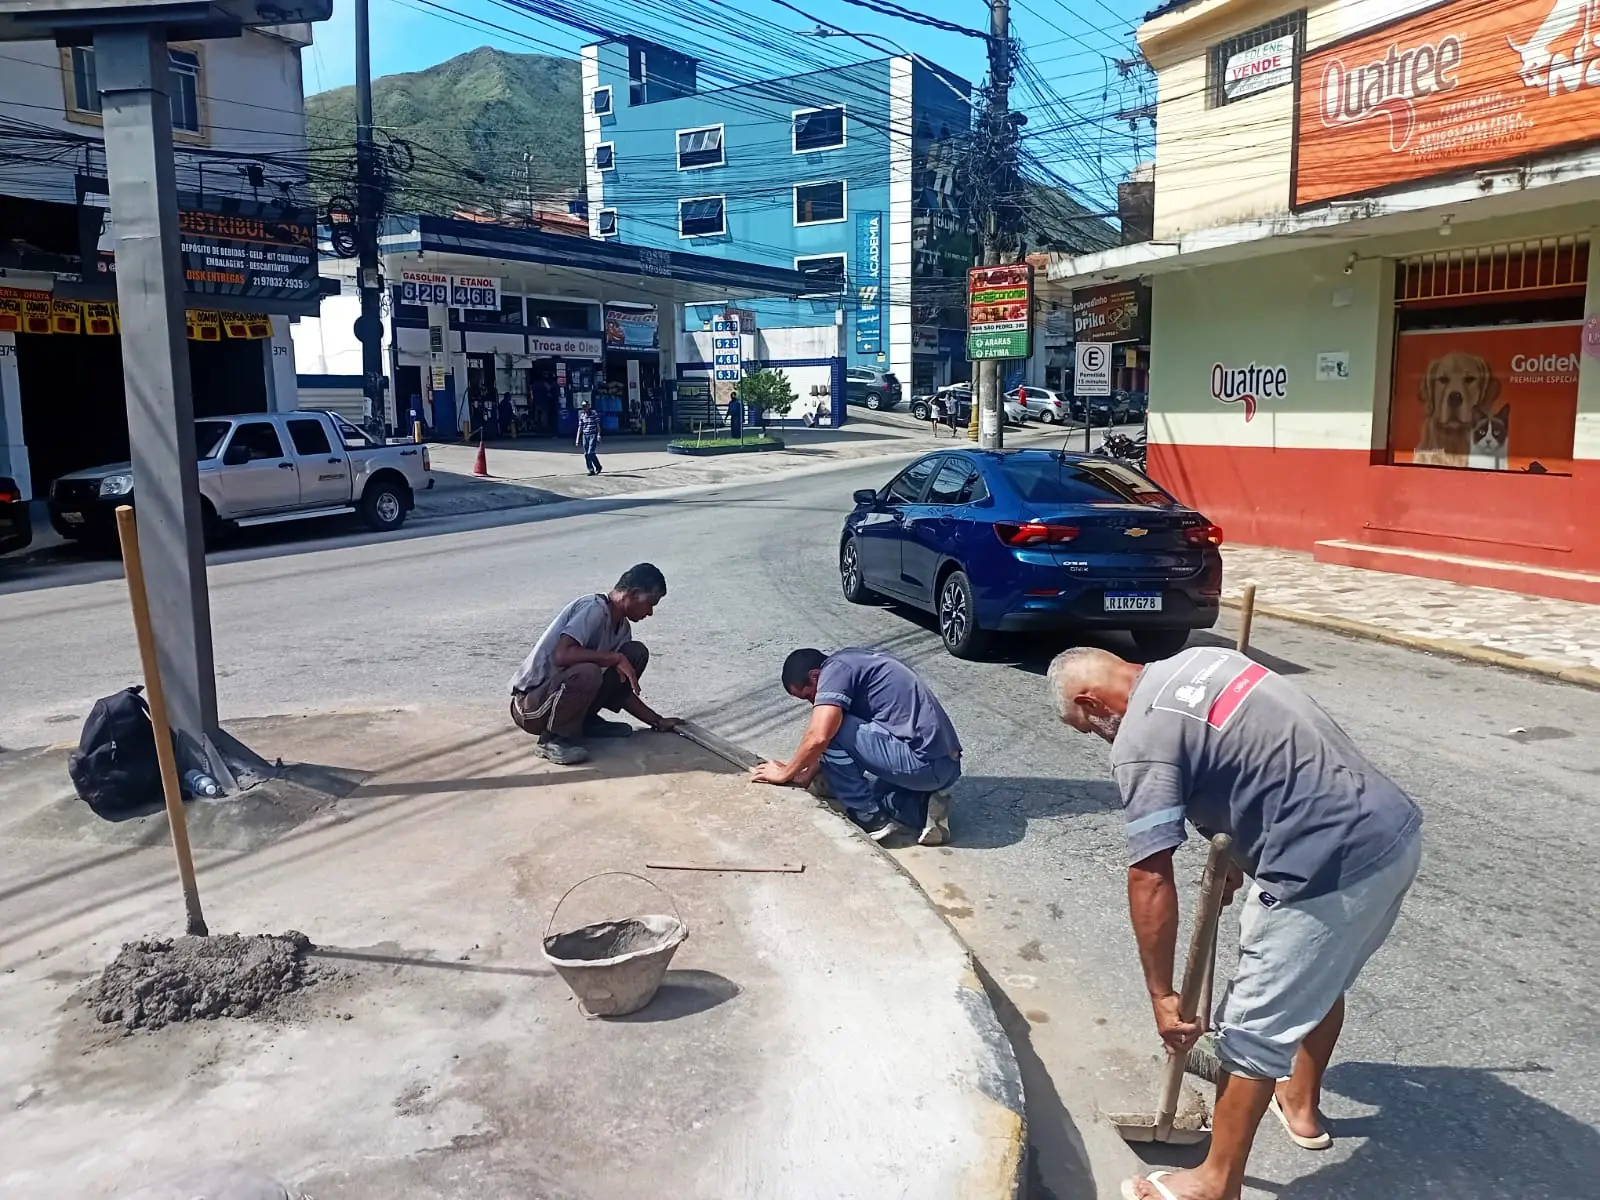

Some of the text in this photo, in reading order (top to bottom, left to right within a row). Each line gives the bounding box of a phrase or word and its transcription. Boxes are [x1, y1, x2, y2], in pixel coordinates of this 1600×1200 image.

[1232, 55, 1281, 80] VENDE
[1320, 34, 1463, 153] Quatree
[1419, 111, 1523, 145] ARTIGOS PARA PESCA
[181, 242, 211, 254] DEPÓSITO
[869, 217, 880, 279] ACADEMIA
[186, 269, 245, 284] DISK ENTREGAS
[402, 272, 448, 283] GASOLINA
[459, 277, 495, 287] ETANOL
[23, 291, 50, 300] OFERTA
[1074, 312, 1106, 333] Drika
[273, 346, 288, 356] 379
[531, 339, 562, 352] Troca
[564, 341, 576, 352] de
[1088, 351, 1099, 366] E
[1509, 375, 1544, 384] PREMIUM
[1211, 363, 1287, 423] Quatree
[1109, 597, 1156, 609] RIR7G78
